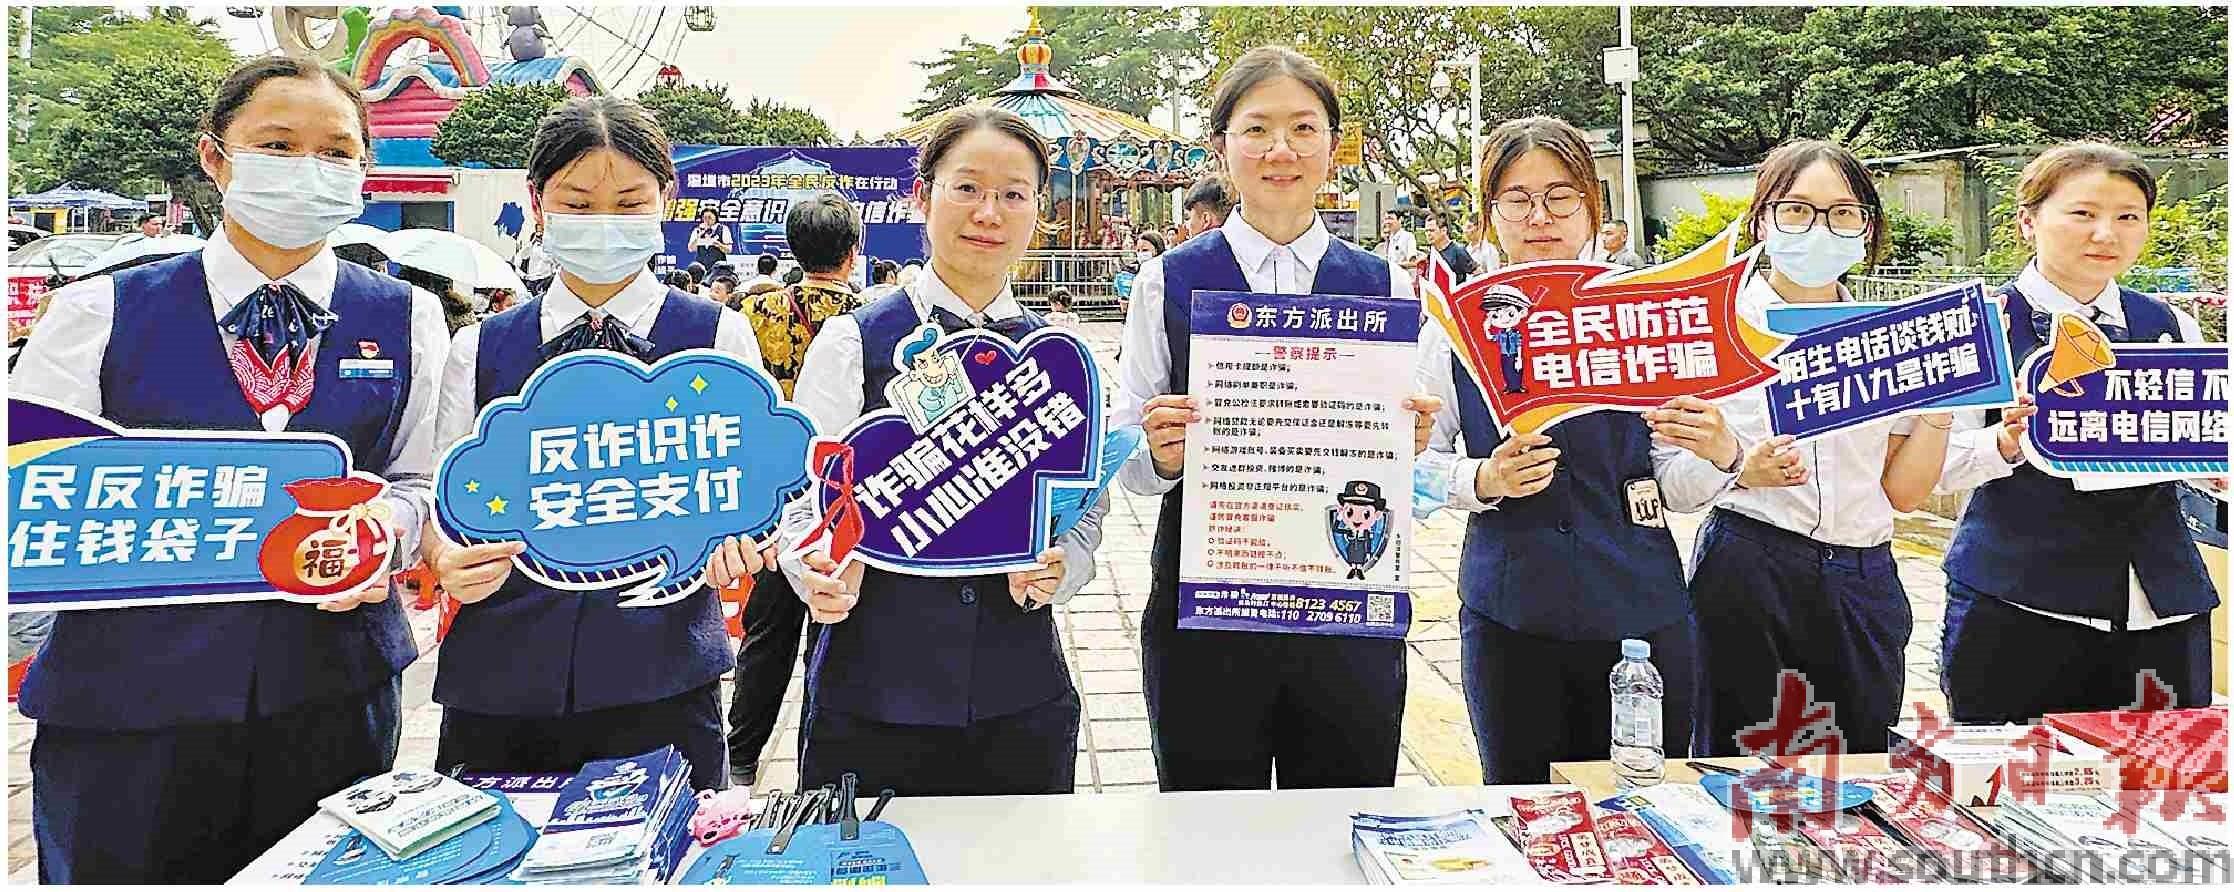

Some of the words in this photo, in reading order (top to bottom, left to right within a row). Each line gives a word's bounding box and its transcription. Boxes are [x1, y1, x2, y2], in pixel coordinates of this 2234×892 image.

[1255, 305, 1388, 333] 东方派出所
[1528, 296, 1714, 348] 全民防范
[1273, 345, 1338, 361] 警察提示
[1531, 340, 1719, 389] 电信诈骗
[1777, 304, 1975, 386] 陌生电话谈钱财
[1785, 342, 1981, 421] 十有八九是诈骗
[2105, 368, 2195, 401] 不轻信
[529, 412, 742, 475] 反诈识诈
[852, 356, 1052, 520] 诈骗花样多
[2048, 409, 2229, 443] 远离电信网络
[8, 464, 269, 511] 民反诈骗
[529, 465, 743, 531] 安全支付
[890, 390, 1088, 559] 小心准没错
[9, 516, 258, 568] 住钱袋子
[303, 540, 347, 579] 福
[1296, 598, 1326, 610] 8123
[1329, 599, 1363, 613] 4567
